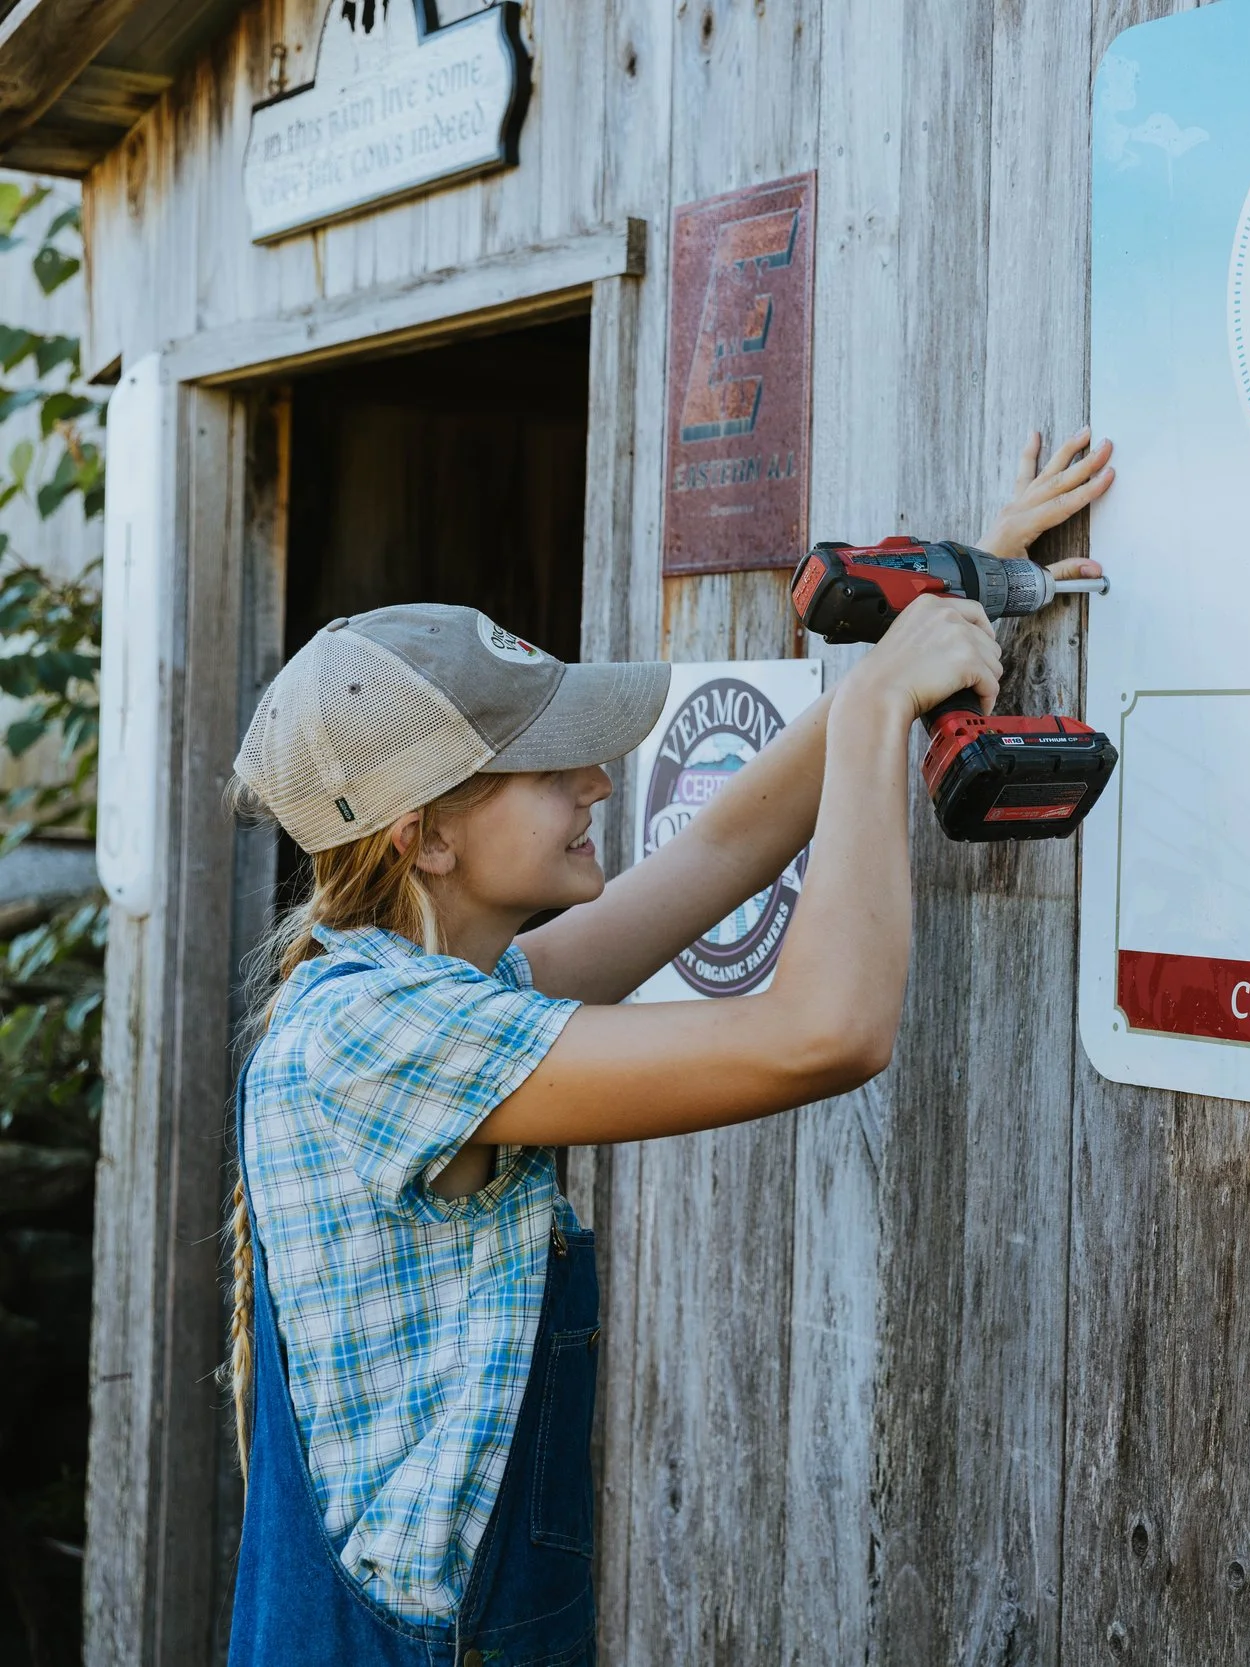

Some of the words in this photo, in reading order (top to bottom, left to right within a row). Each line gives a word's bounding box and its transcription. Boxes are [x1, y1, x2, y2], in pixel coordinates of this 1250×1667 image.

[674, 453, 762, 492] EASTERN
[659, 687, 786, 767] VERMON
[696, 958, 747, 983] ORGANIC
[745, 901, 790, 973] FARMERS
